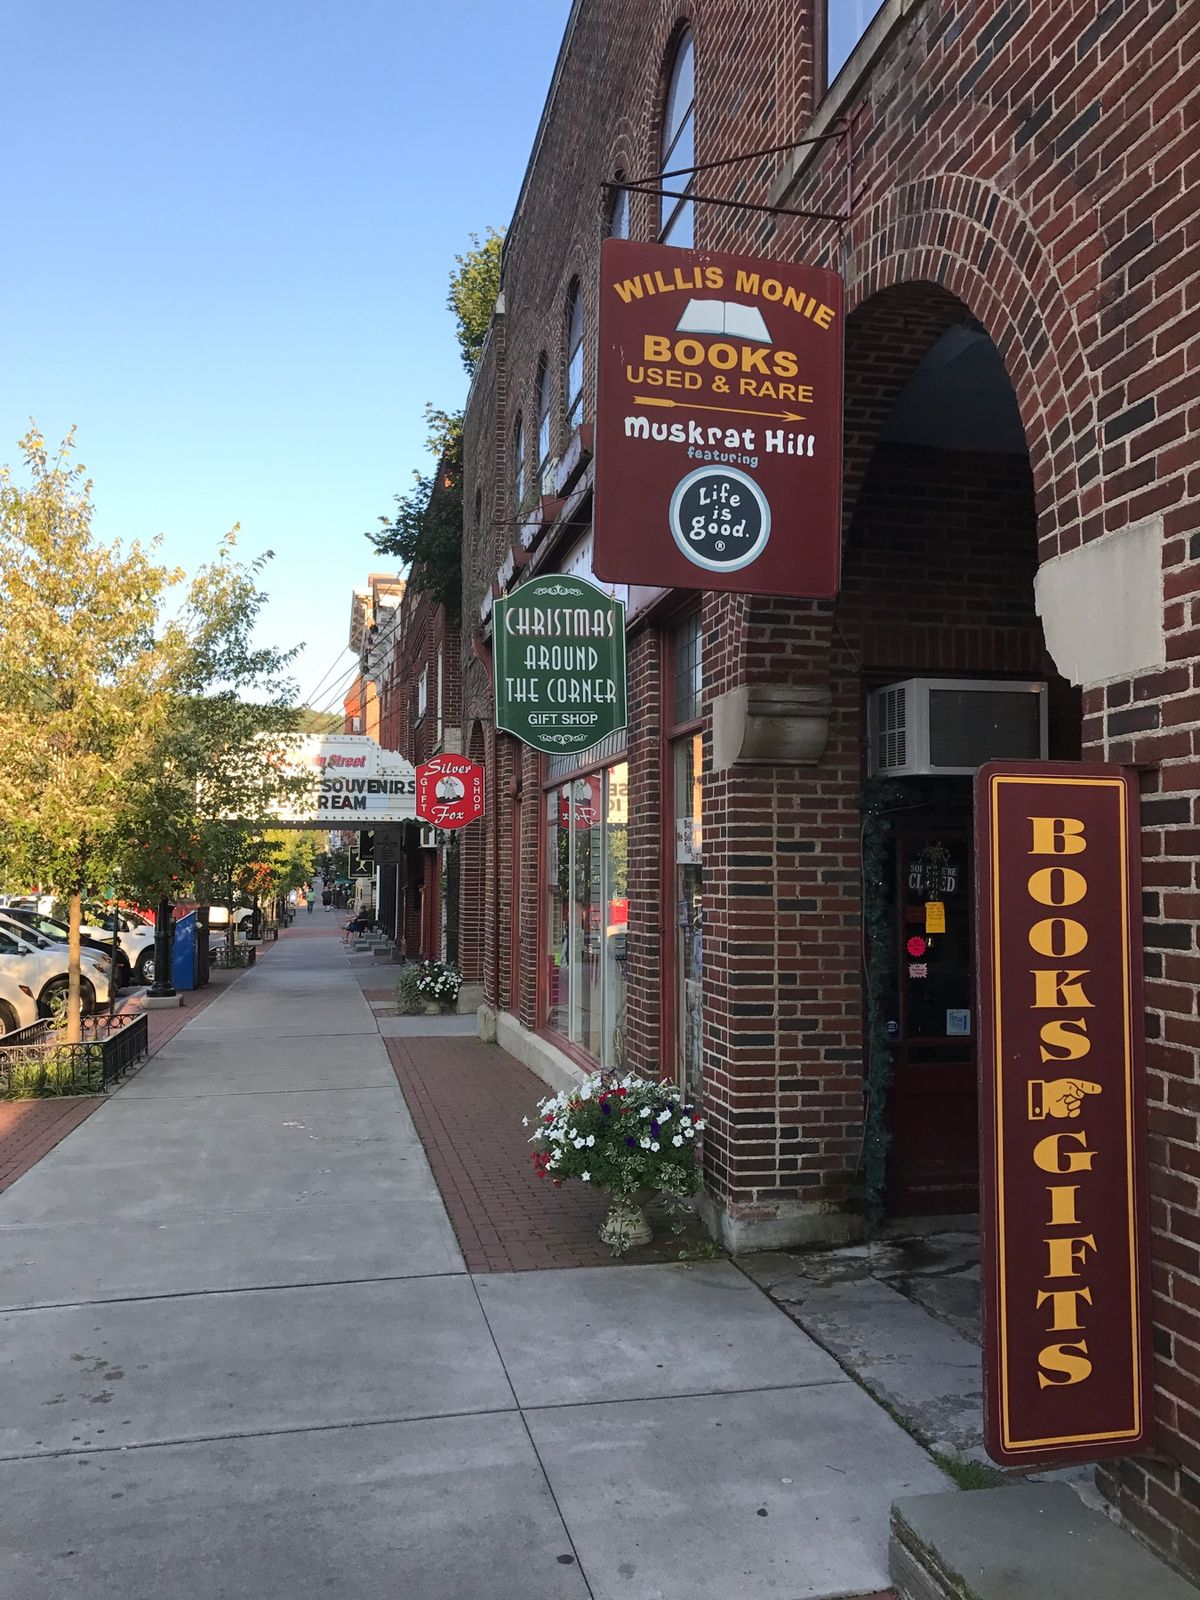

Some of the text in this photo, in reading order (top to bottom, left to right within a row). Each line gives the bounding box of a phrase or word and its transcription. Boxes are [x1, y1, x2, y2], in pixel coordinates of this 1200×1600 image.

[613, 266, 836, 330] WILLIS MONIE
[643, 334, 799, 378] BOOKS
[626, 364, 814, 403] USED & RARE
[765, 429, 815, 457] Hill
[687, 446, 759, 468] featuring
[699, 483, 741, 507] Life
[712, 505, 732, 520] is
[689, 515, 750, 540] good.
[505, 607, 615, 637] CHRISTMAS
[524, 645, 598, 671] AROUND
[505, 678, 616, 703] THE CORNER
[528, 713, 598, 725] GIFT SHOP
[330, 754, 367, 768] Street
[423, 759, 472, 776] Silver
[321, 778, 416, 795] SOUVENIRS
[420, 777, 428, 812] GIFT
[473, 777, 481, 812] SHOP
[430, 805, 464, 824] Fox
[1026, 816, 1098, 1390] BOOKS GIFTS
